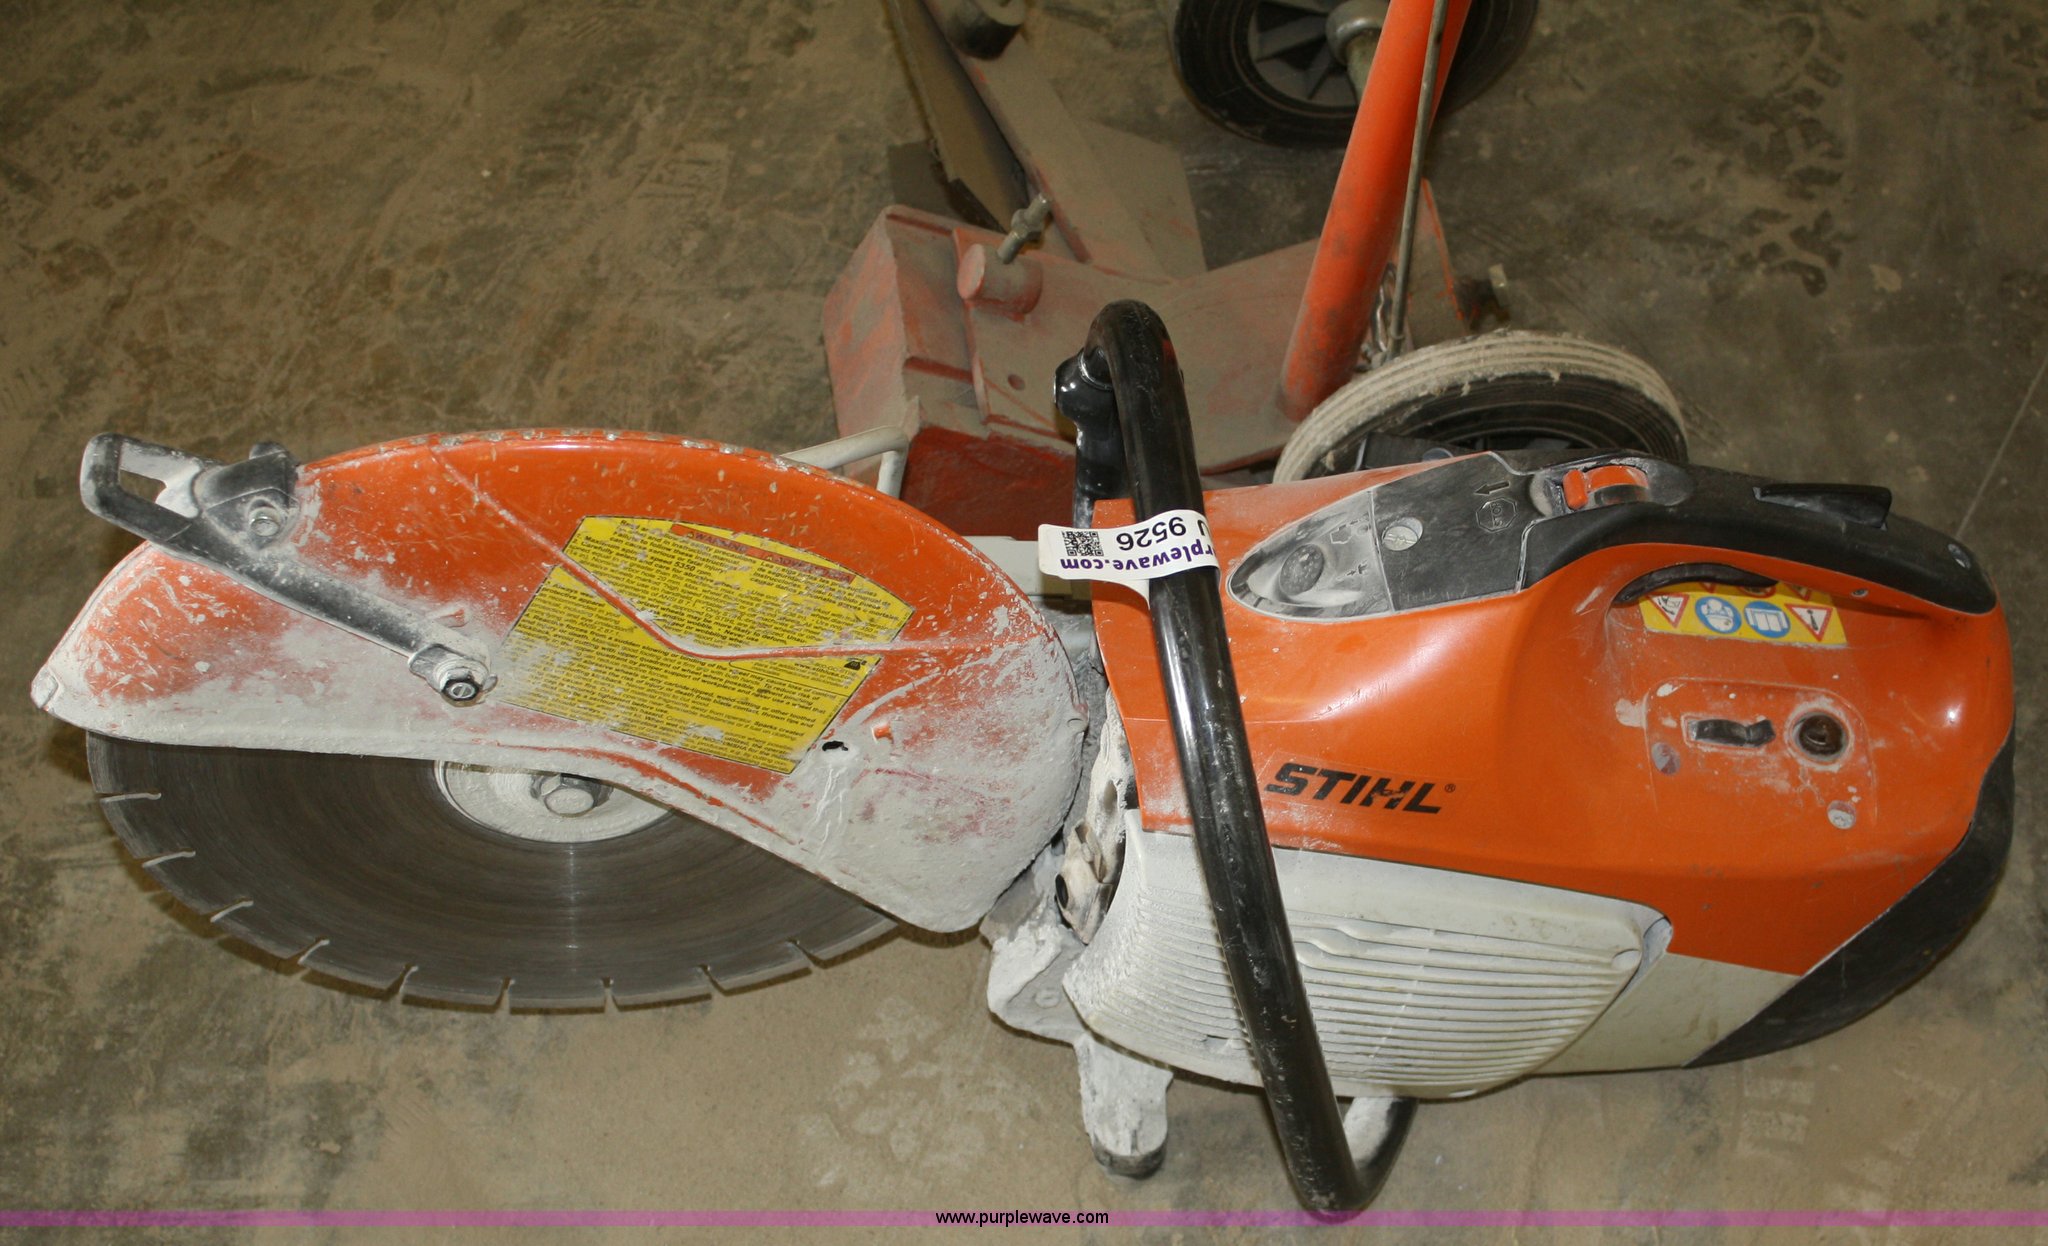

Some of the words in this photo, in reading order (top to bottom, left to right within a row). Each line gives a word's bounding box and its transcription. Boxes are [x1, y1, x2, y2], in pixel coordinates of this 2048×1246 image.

[1116, 517, 1186, 551] 9526
[672, 561, 696, 571] 5350
[1264, 762, 1443, 814] STIHL
